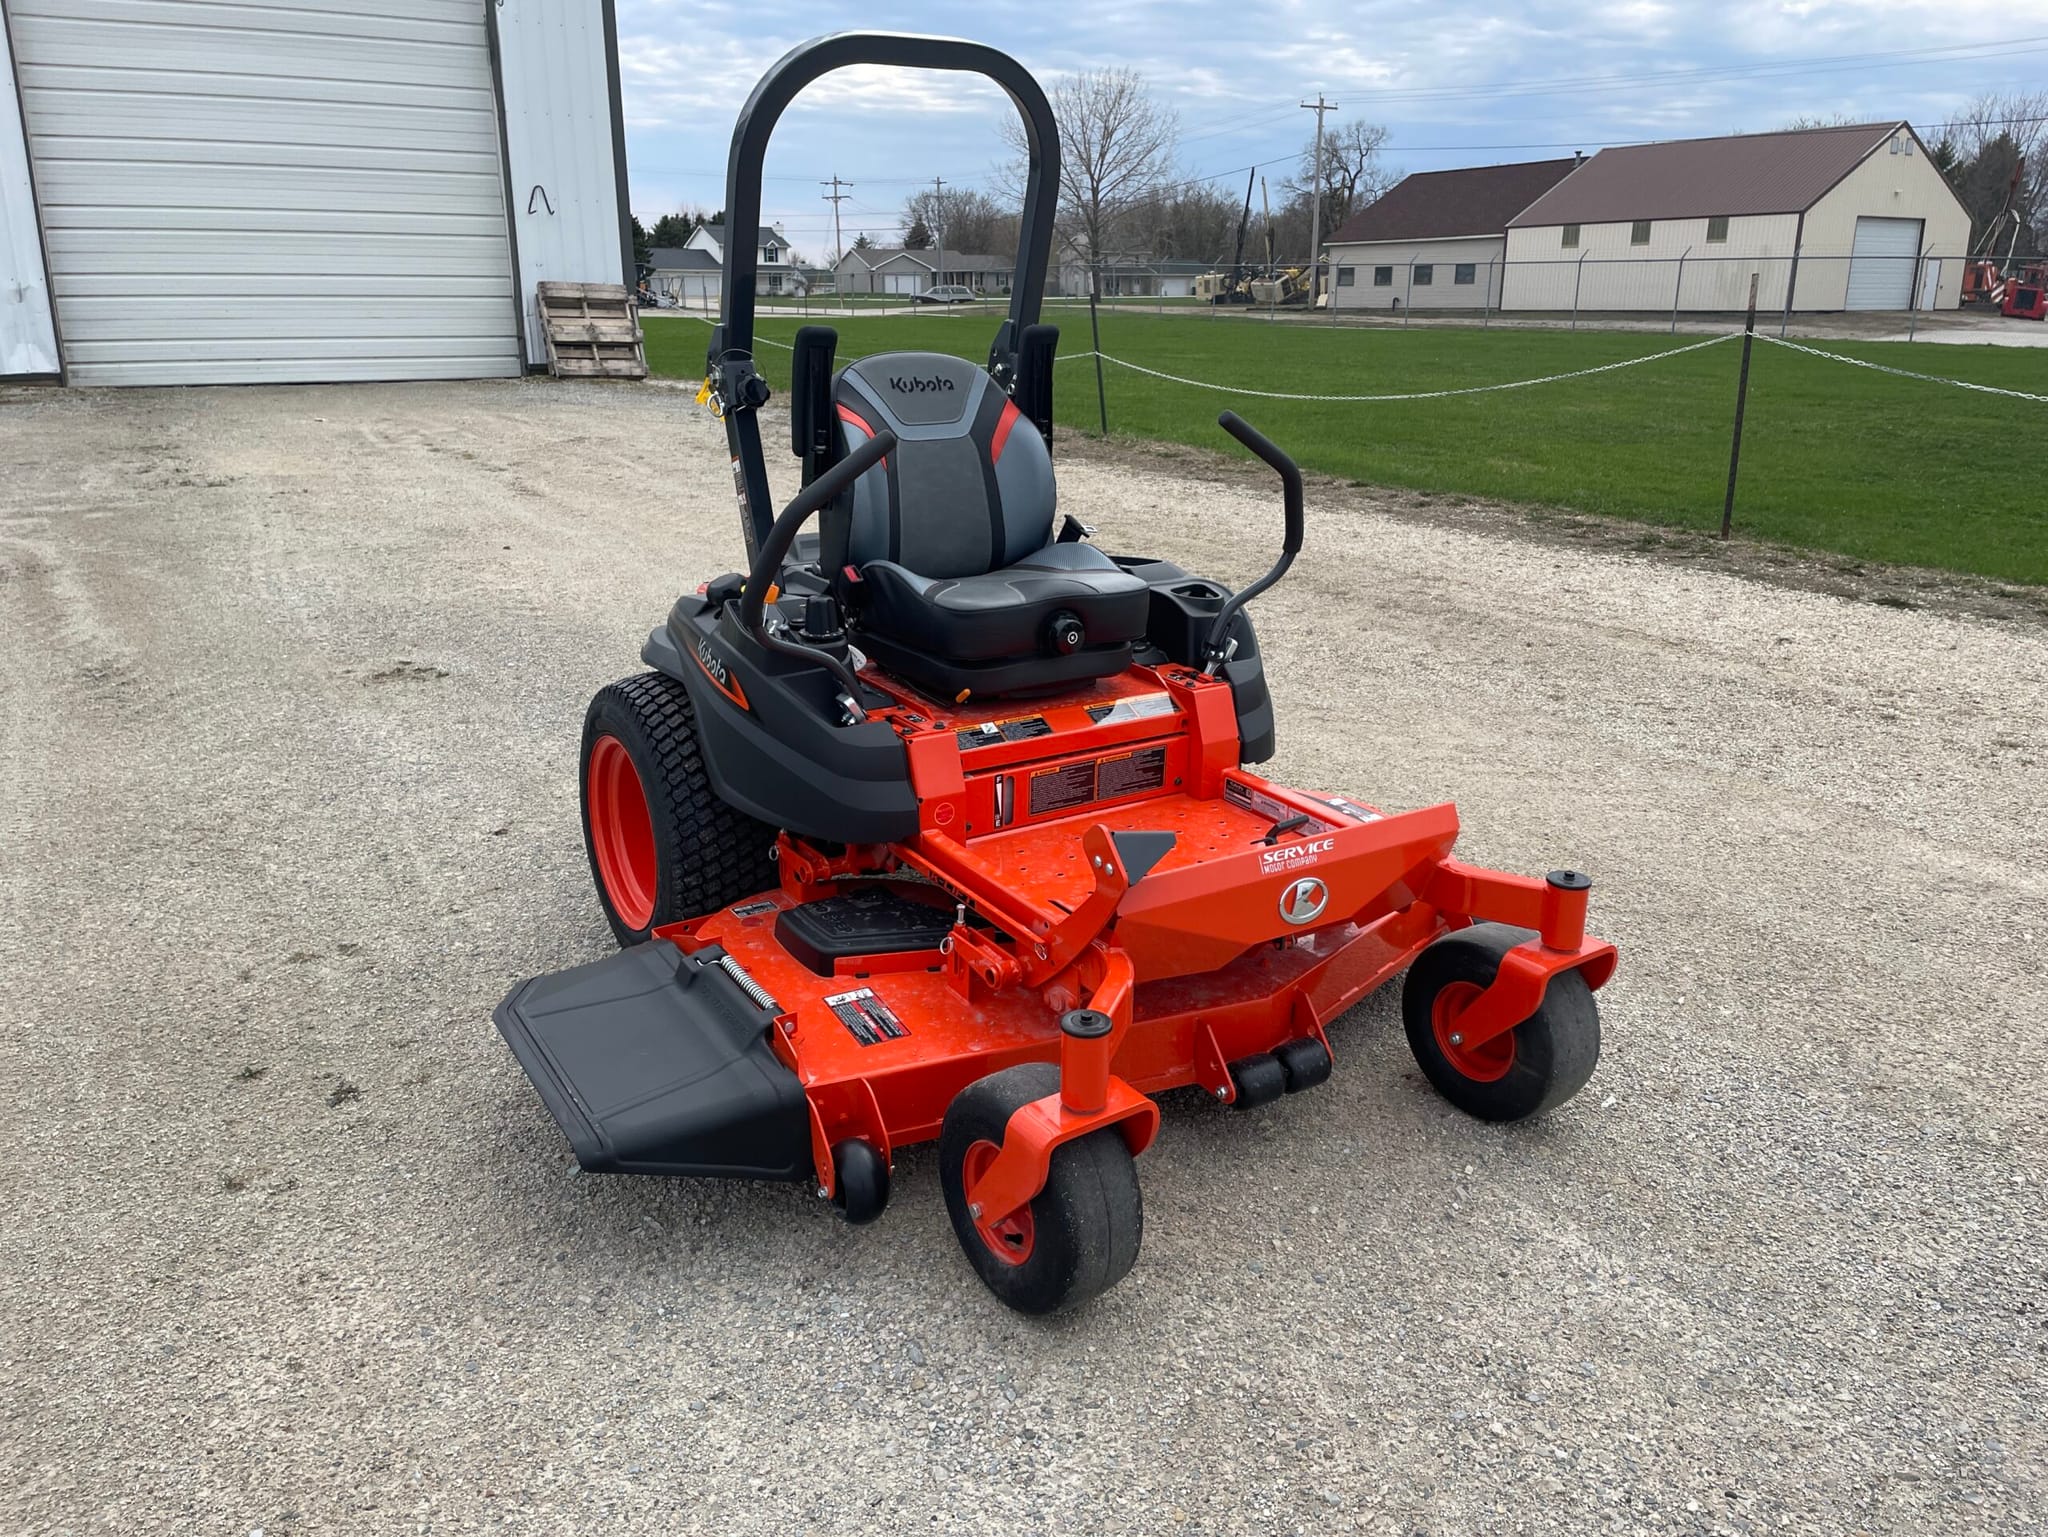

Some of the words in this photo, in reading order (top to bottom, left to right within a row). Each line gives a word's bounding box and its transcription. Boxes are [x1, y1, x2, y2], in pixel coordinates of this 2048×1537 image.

[889, 375, 954, 393] Kubota
[697, 636, 726, 685] Kubota
[1263, 838, 1335, 865] SERVICE
